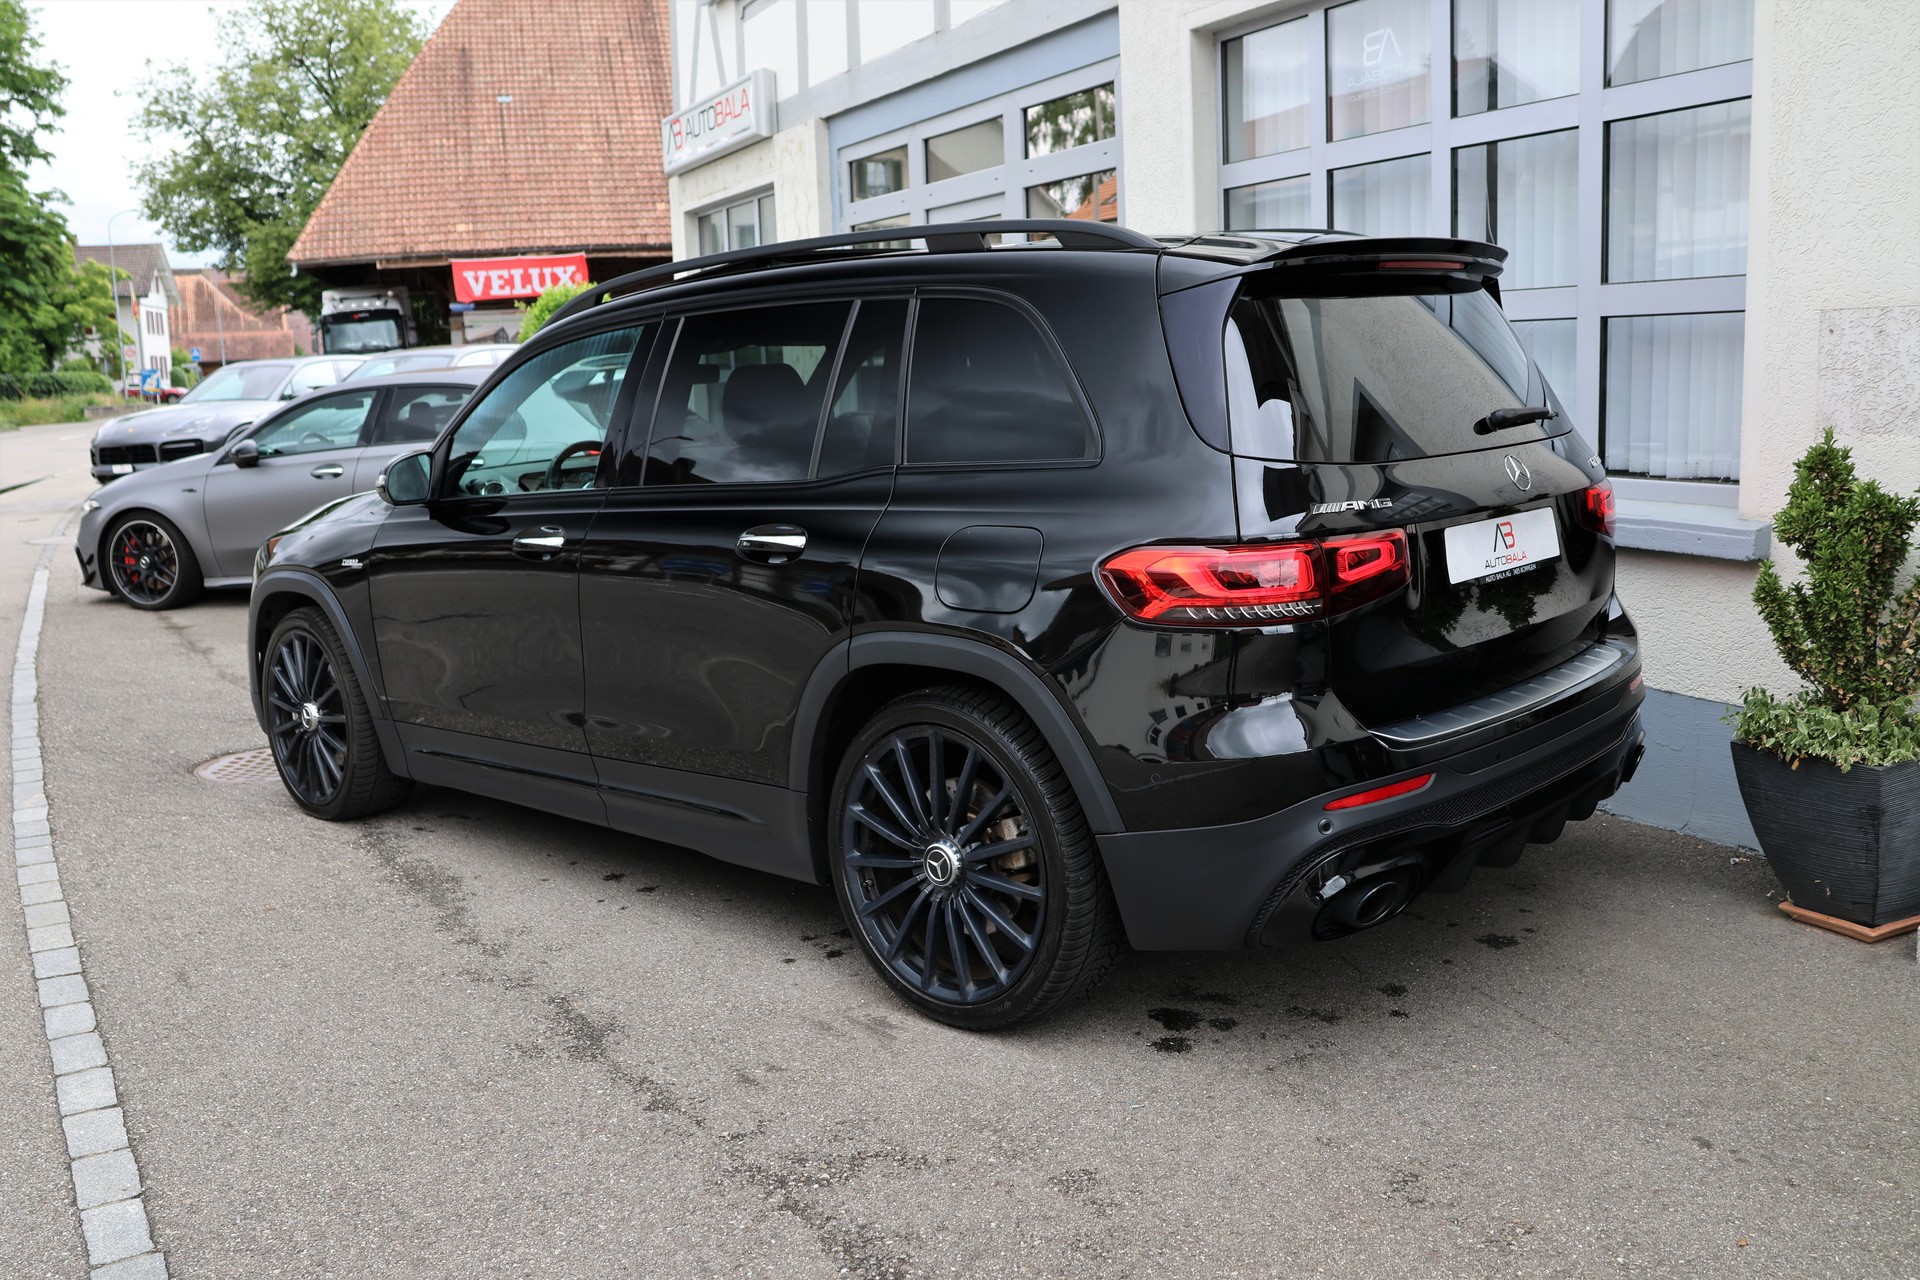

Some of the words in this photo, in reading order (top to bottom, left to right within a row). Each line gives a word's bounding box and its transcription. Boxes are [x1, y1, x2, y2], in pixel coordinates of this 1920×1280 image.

[685, 88, 750, 140] AUTOBALA
[463, 265, 577, 297] VELUX
[1341, 498, 1393, 512] AMG
[1484, 551, 1528, 570] AUTOBALA
